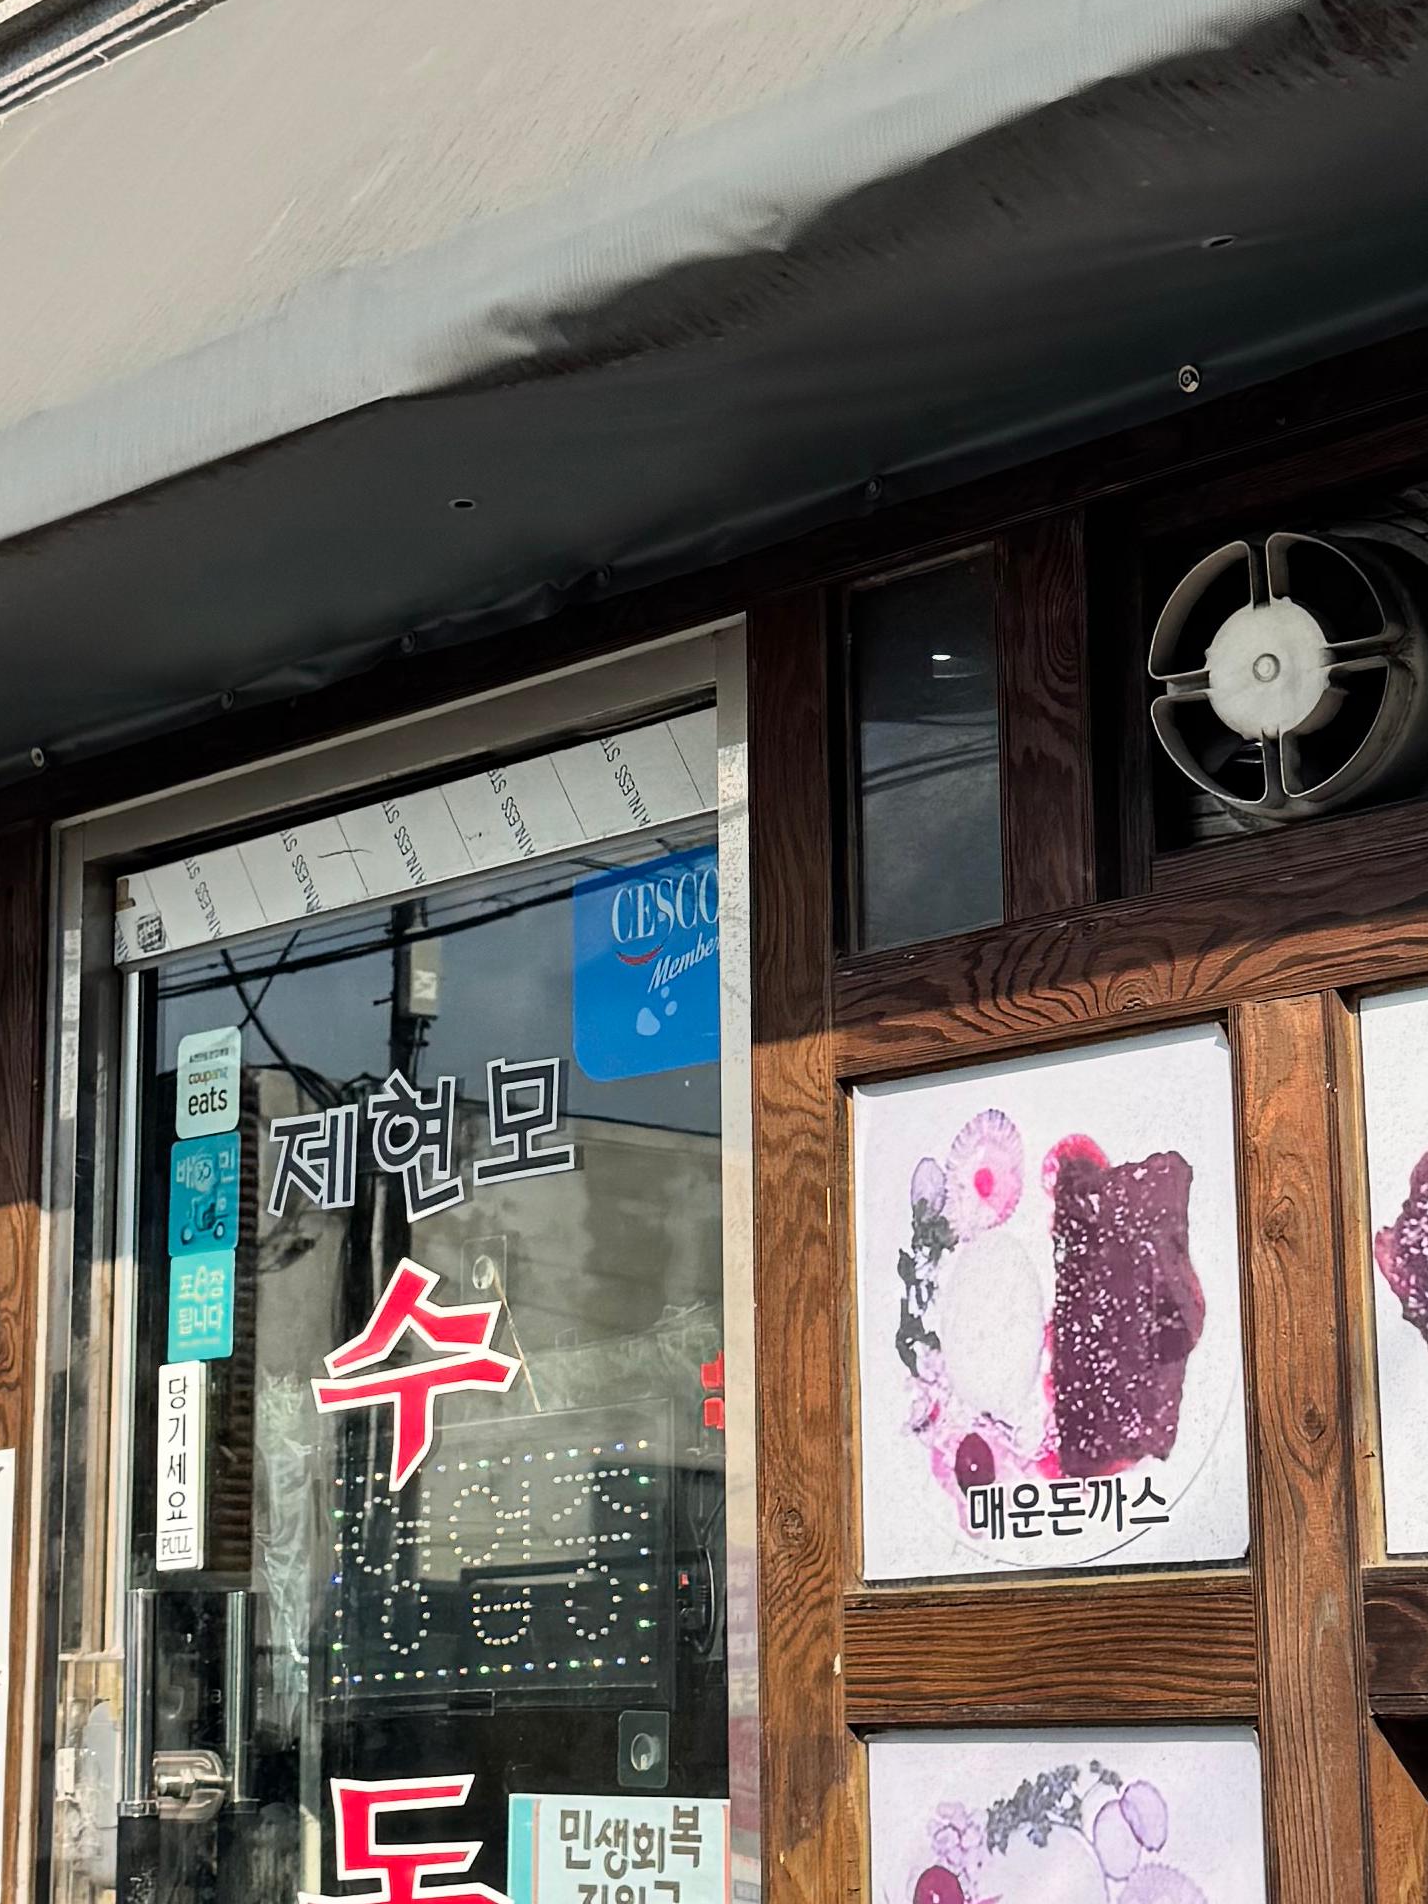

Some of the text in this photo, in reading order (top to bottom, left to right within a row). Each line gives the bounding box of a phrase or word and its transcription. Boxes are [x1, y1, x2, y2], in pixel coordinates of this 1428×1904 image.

[612, 869, 720, 944] CESCO
[188, 1086, 228, 1116] eats
[268, 1056, 576, 1224] 제현모
[310, 1255, 523, 1493] 수
[166, 1375, 189, 1522] 당기세요
[161, 1535, 192, 1556] PULL
[968, 1475, 1171, 1542] 매운돈까스
[352, 1468, 636, 1656] 영업중
[560, 1804, 703, 1880] 민생회복
